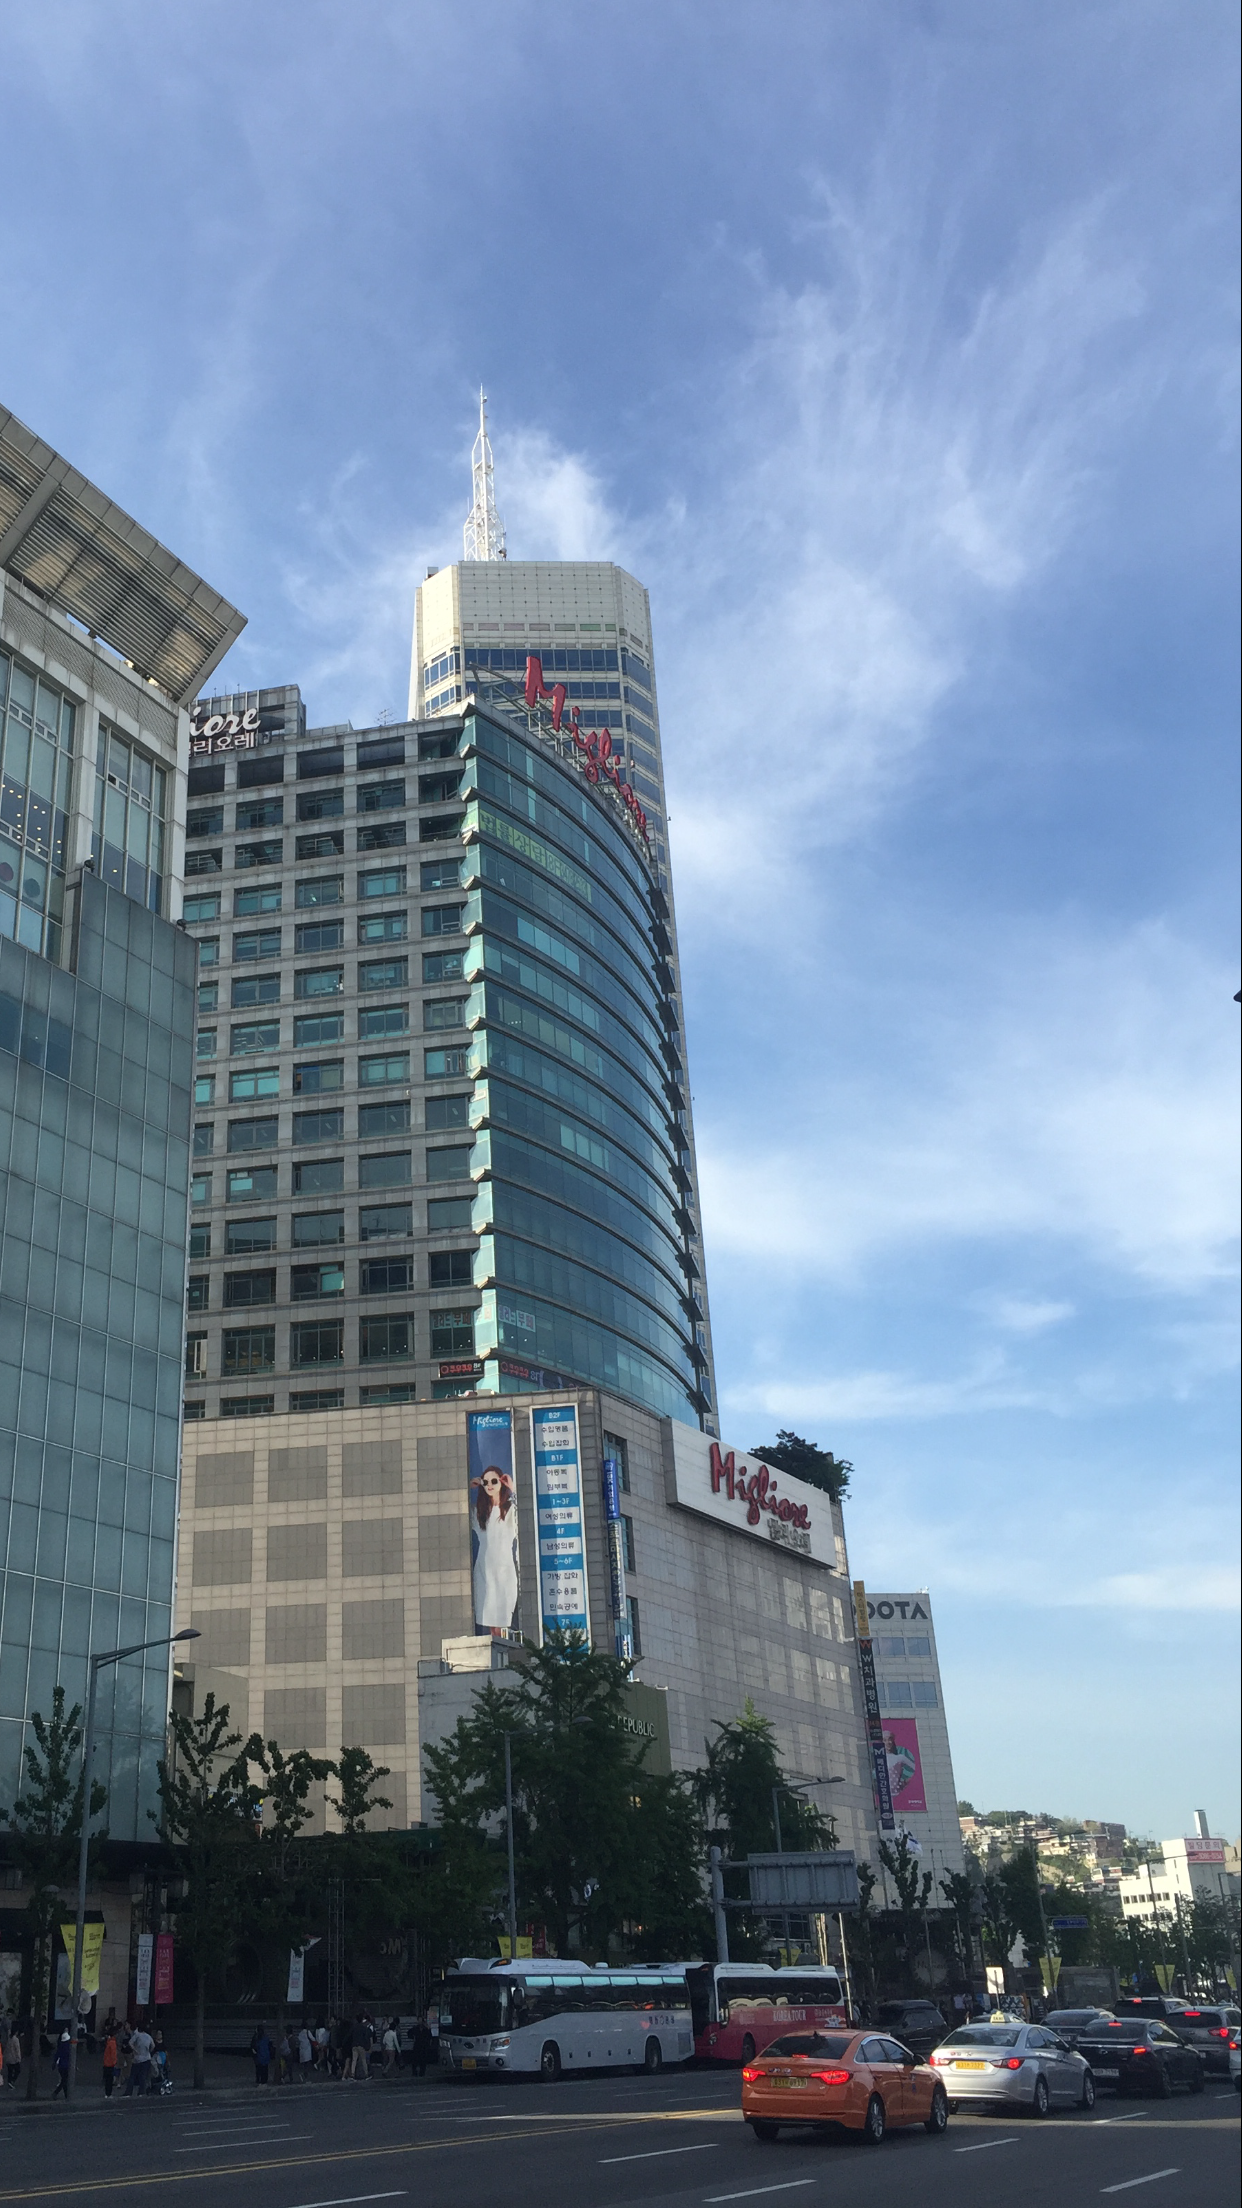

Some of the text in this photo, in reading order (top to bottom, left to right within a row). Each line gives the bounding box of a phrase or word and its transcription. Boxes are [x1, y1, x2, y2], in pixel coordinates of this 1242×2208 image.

[189, 732, 255, 758] 리오레
[551, 1454, 564, 1462] B1F
[709, 1442, 811, 1529] Migliore
[545, 1512, 573, 1520] 여성의류
[556, 1527, 565, 1535] 4F
